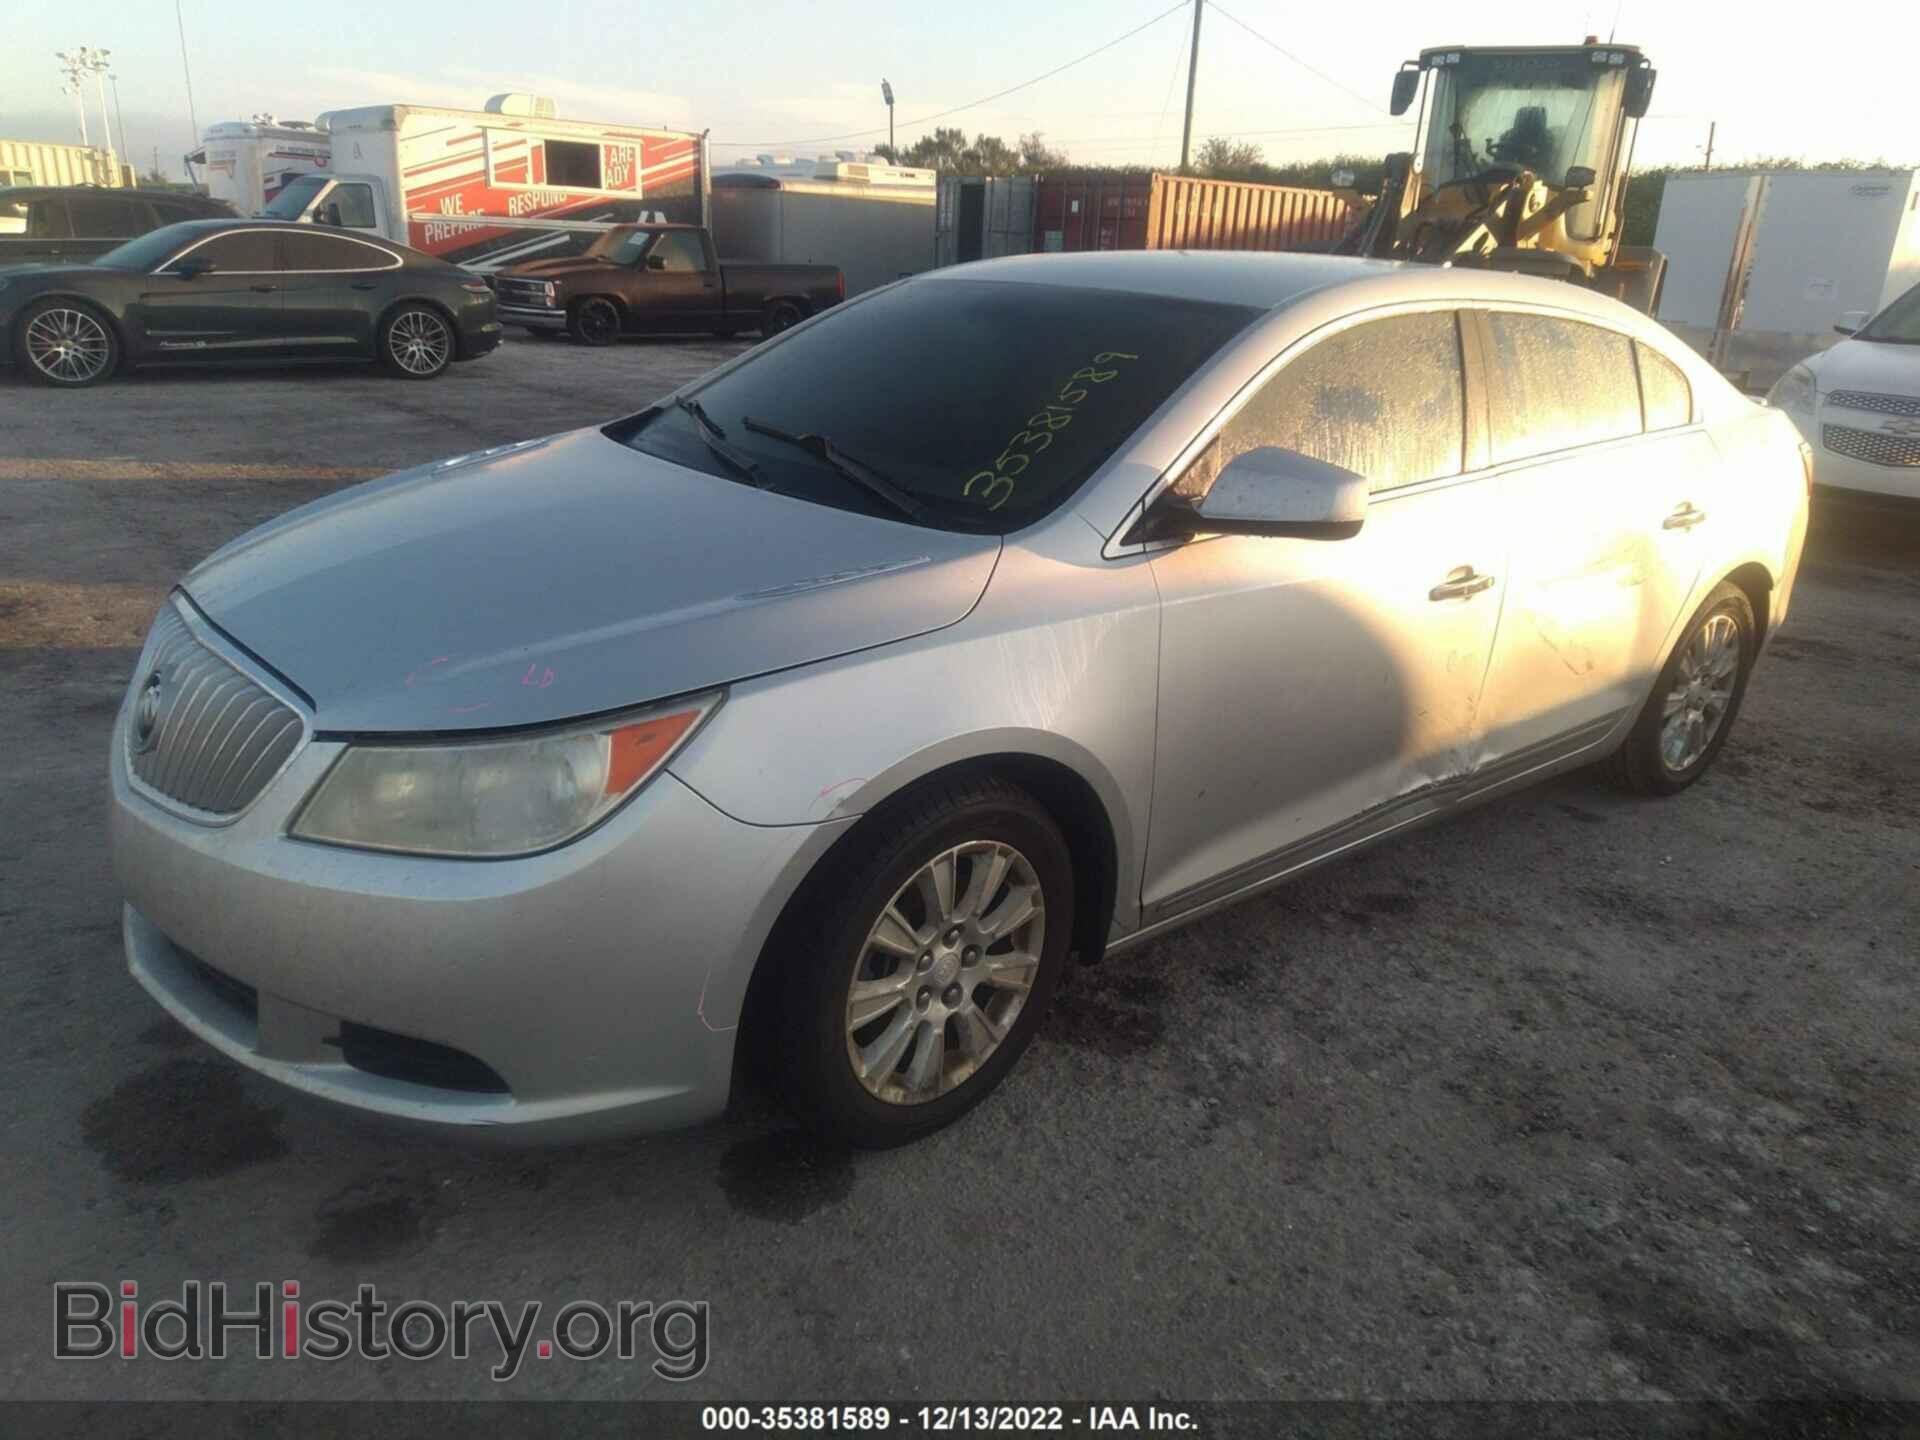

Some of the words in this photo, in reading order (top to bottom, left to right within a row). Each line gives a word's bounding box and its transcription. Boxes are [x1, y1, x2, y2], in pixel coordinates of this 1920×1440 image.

[610, 145, 636, 167] ARE
[440, 192, 464, 216] WE
[963, 352, 1139, 511] 35381589
